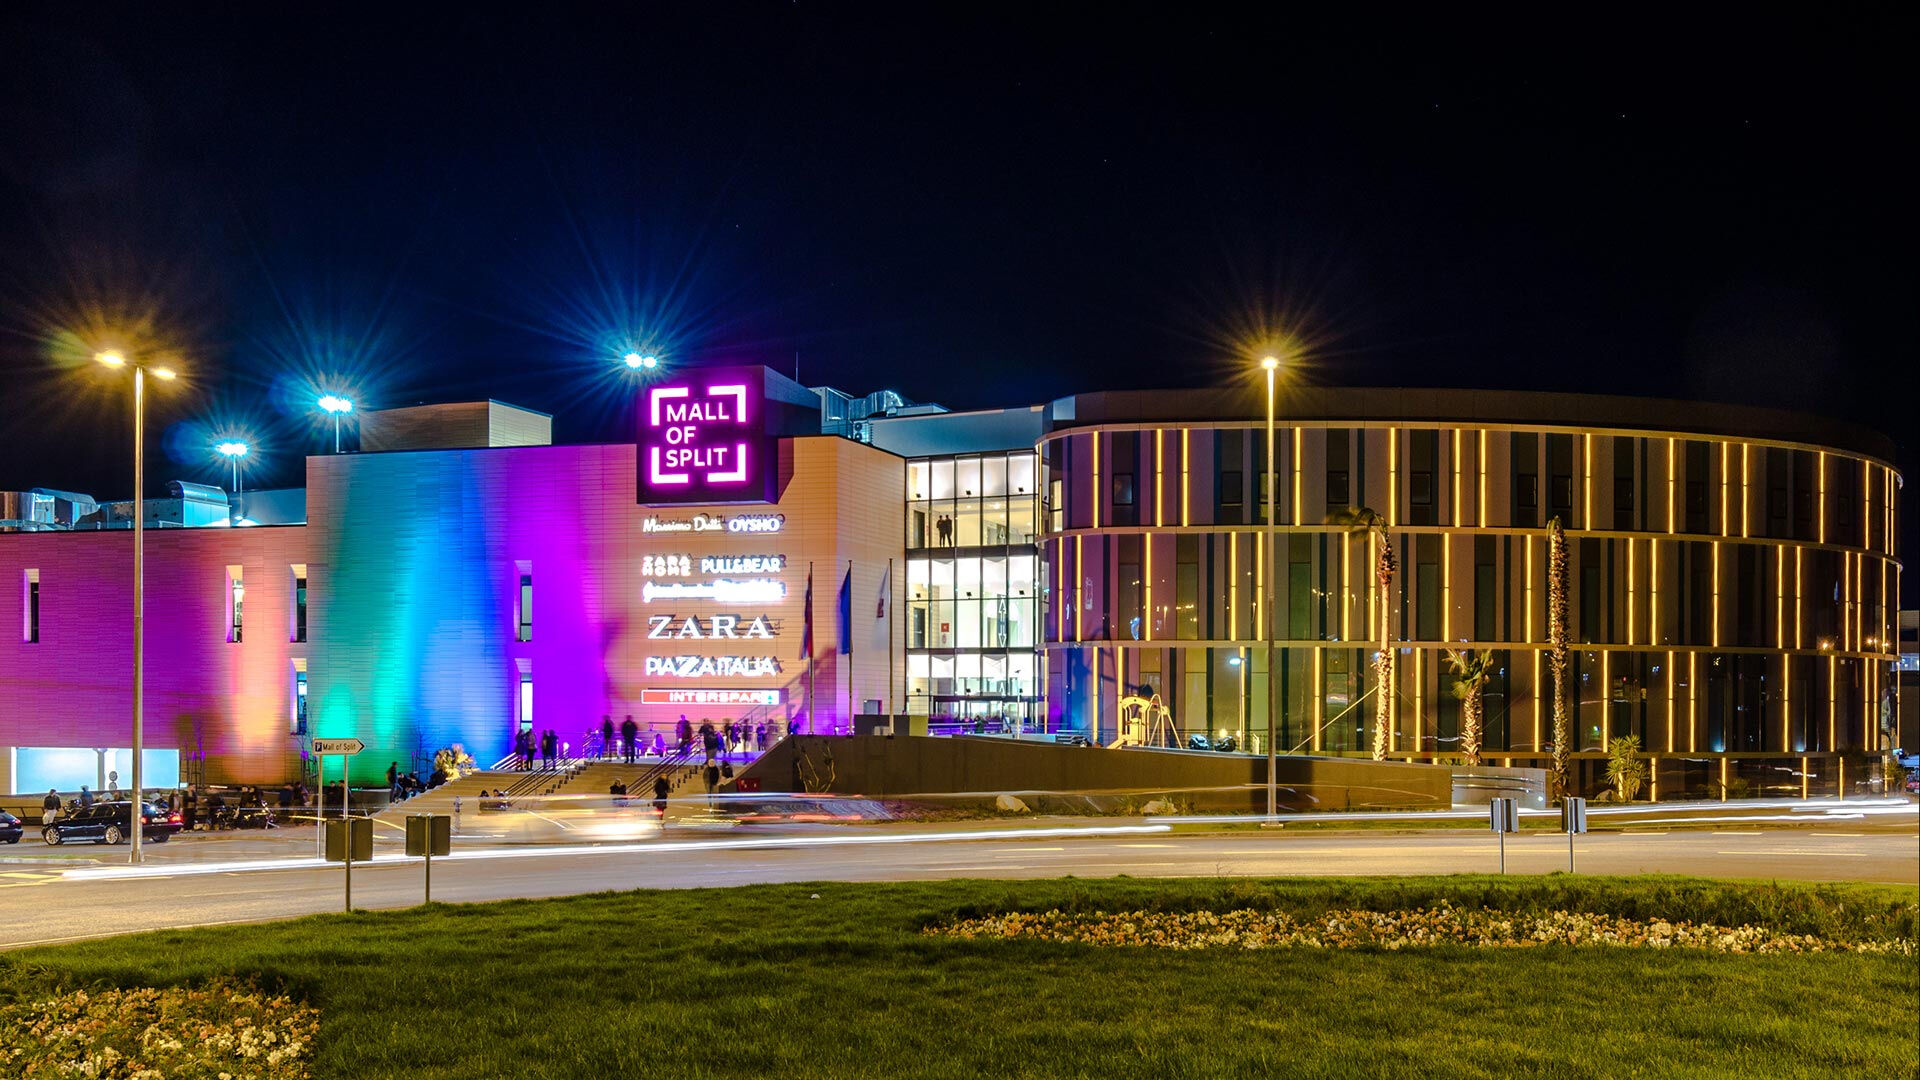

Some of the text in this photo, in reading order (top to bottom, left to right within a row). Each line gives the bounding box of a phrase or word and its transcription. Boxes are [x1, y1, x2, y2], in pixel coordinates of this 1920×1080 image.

[666, 402, 730, 422] MALL
[665, 426, 697, 444] OF
[665, 448, 728, 467] SPLIT
[728, 518, 781, 532] OYSHO
[643, 556, 691, 566] ZARA
[701, 557, 781, 574] PULL&BEAR
[642, 565, 691, 577] HOME
[647, 616, 774, 639] ZARA
[669, 692, 761, 702] INTERSPAR
[343, 743, 356, 751] Split
